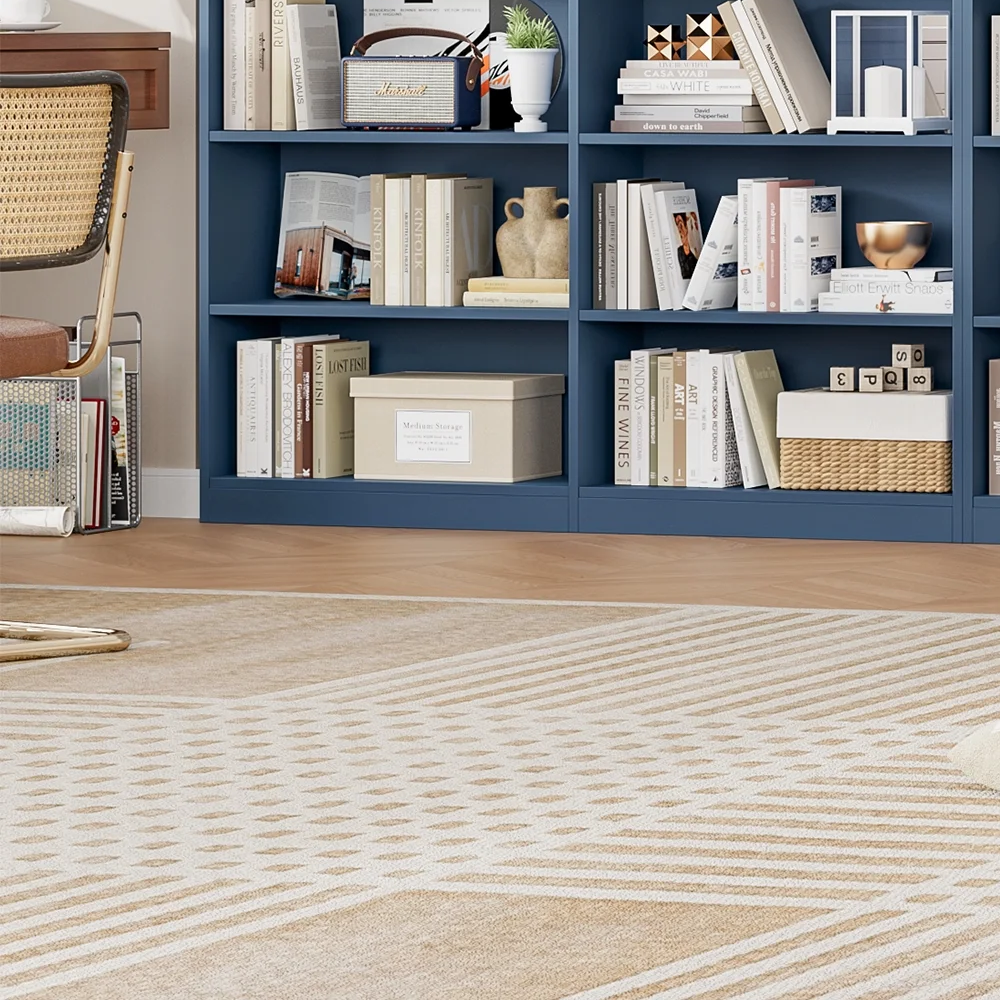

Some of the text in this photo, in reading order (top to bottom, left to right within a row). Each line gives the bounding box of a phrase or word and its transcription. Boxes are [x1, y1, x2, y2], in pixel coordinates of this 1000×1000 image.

[274, 1, 284, 48] RIVERS
[644, 69, 708, 78] CASA WABI
[732, 31, 773, 108] СПАСИТЕ КОТИКА!
[293, 57, 304, 105] BAUHAUS
[374, 81, 427, 96] Marshall
[669, 81, 710, 92] WHITE
[643, 122, 666, 130] down
[680, 122, 703, 130] earth
[373, 207, 382, 269] KINFOLK
[414, 207, 423, 270] KINFOLK
[834, 281, 944, 294] Elliott Erwitt Snaps
[328, 357, 367, 374] LOST FISH
[315, 349, 323, 406] LOST FISH
[634, 356, 645, 410] WINDOWS
[885, 371, 897, 385] Q
[913, 375, 926, 384] 8
[674, 383, 685, 406] ART
[688, 384, 698, 405] ART
[282, 343, 293, 469] ALEXEY BRODOVITCH
[403, 422, 463, 431] Medium Storage
[618, 378, 630, 468] FINE WINES
